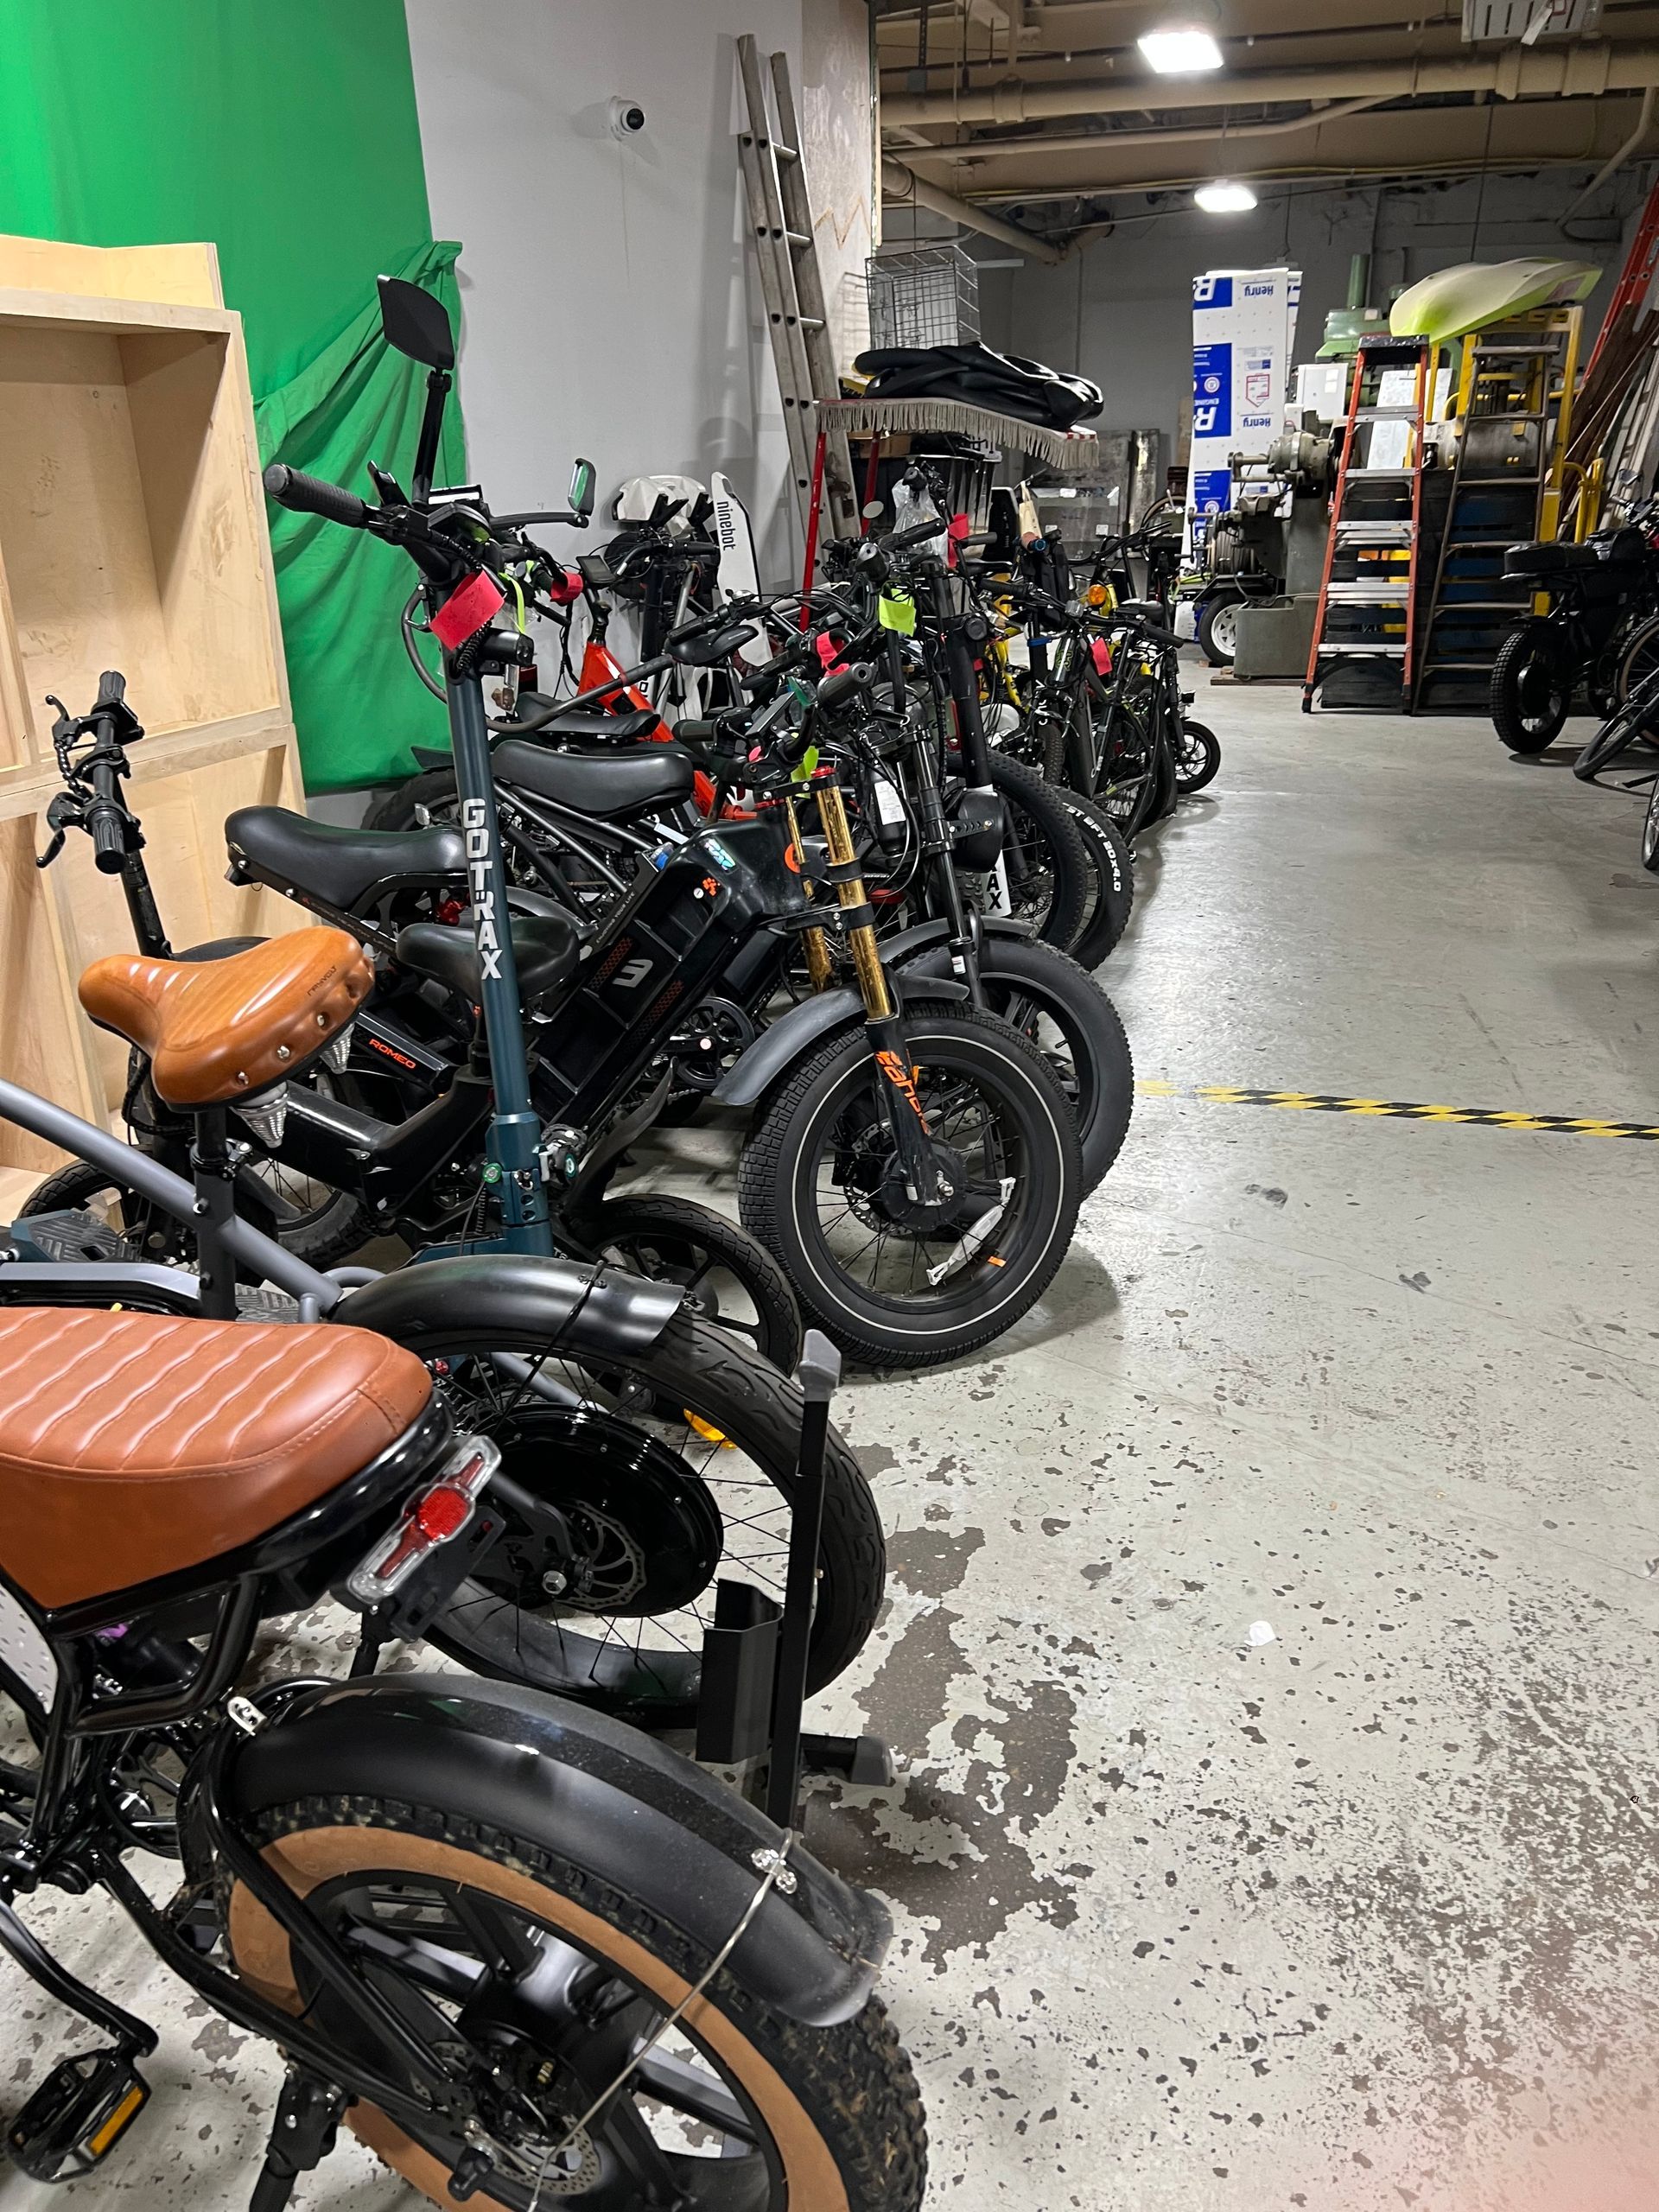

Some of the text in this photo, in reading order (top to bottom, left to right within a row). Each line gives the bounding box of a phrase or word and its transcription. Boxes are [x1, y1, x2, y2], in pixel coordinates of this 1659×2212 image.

[1244, 284, 1274, 296] Henry
[1243, 416, 1271, 428] Henry
[716, 501, 736, 551] ninebot
[462, 798, 502, 980] GOTRAX
[612, 958, 653, 988] 3
[369, 1039, 416, 1069] ROMEO
